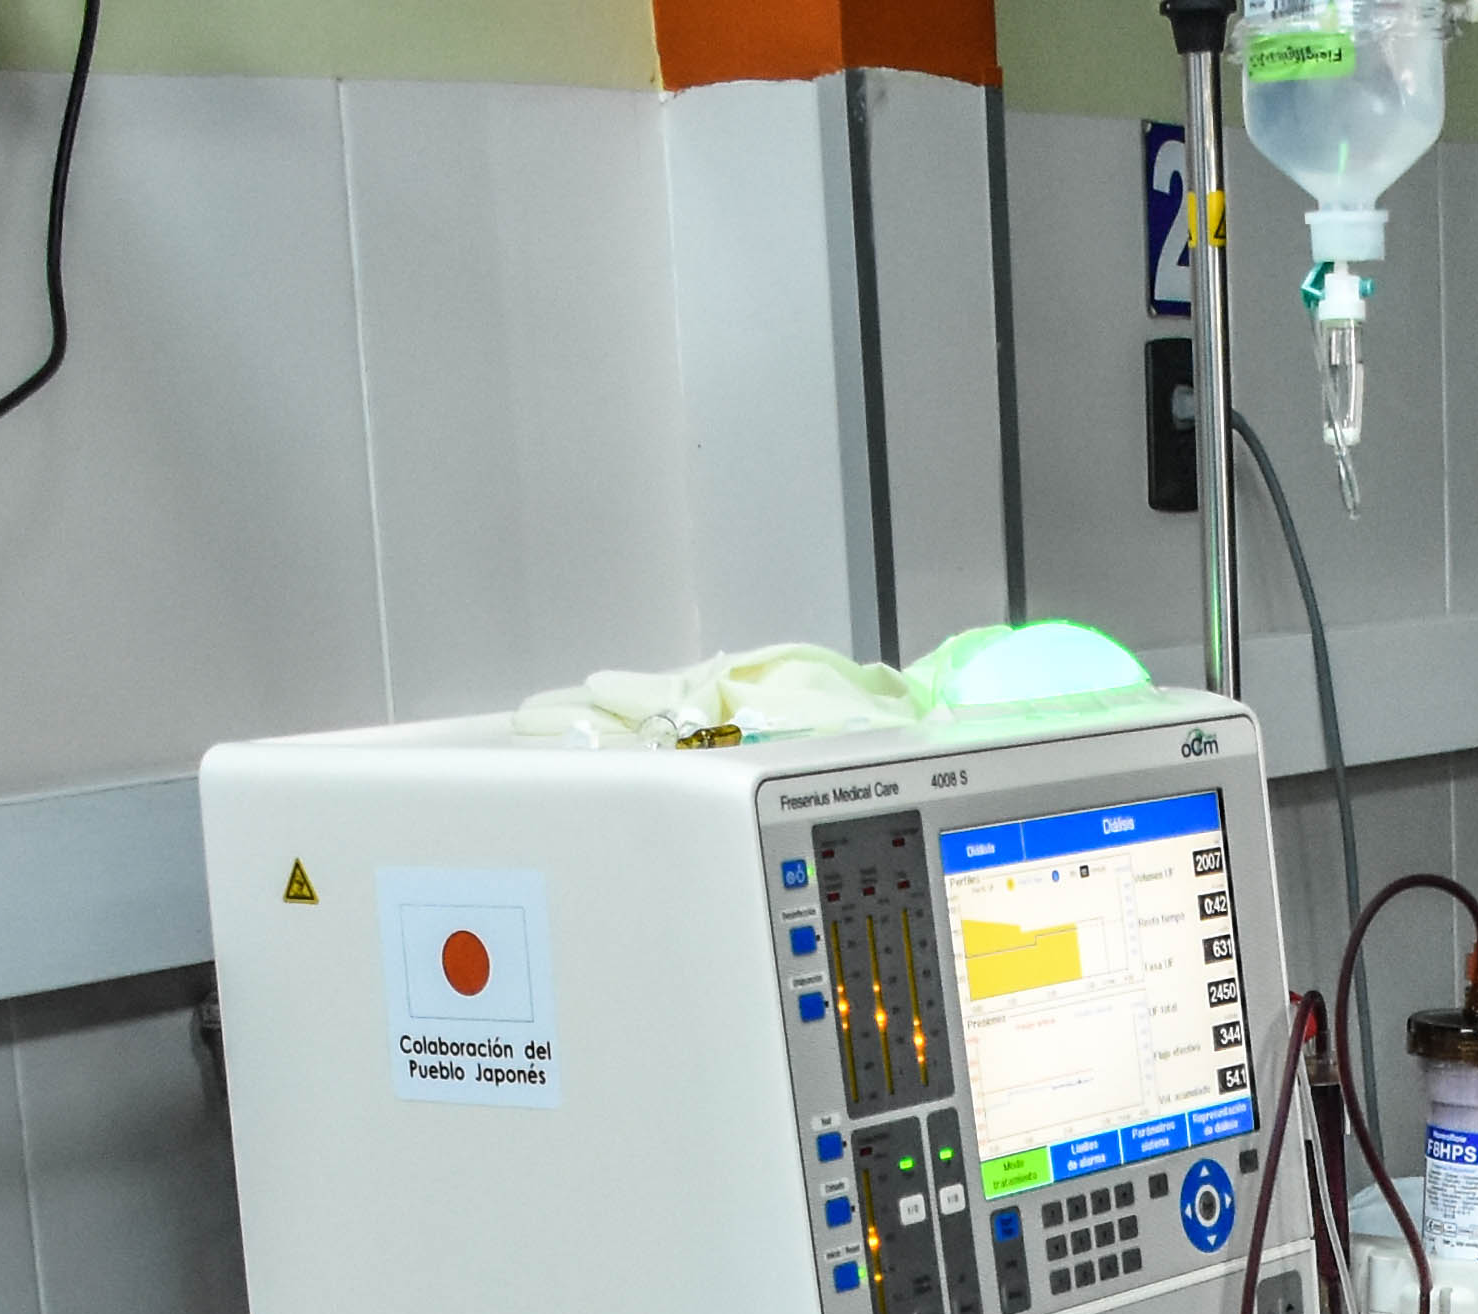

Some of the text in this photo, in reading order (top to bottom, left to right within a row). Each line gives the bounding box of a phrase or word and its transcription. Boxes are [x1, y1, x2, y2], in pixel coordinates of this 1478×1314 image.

[1153, 139, 1192, 302] 2
[780, 769, 969, 811] Fresenius Medical Care 4008 S
[1195, 852, 1221, 872] 2007
[1203, 895, 1228, 915] 0:42
[1212, 939, 1233, 958] 631
[1209, 982, 1237, 1003] 2450
[1220, 1025, 1242, 1045] 344
[400, 1035, 552, 1060] Colaboración del
[409, 1060, 547, 1087] Pueblo Japonés
[1426, 1138, 1478, 1163] F8HPS
